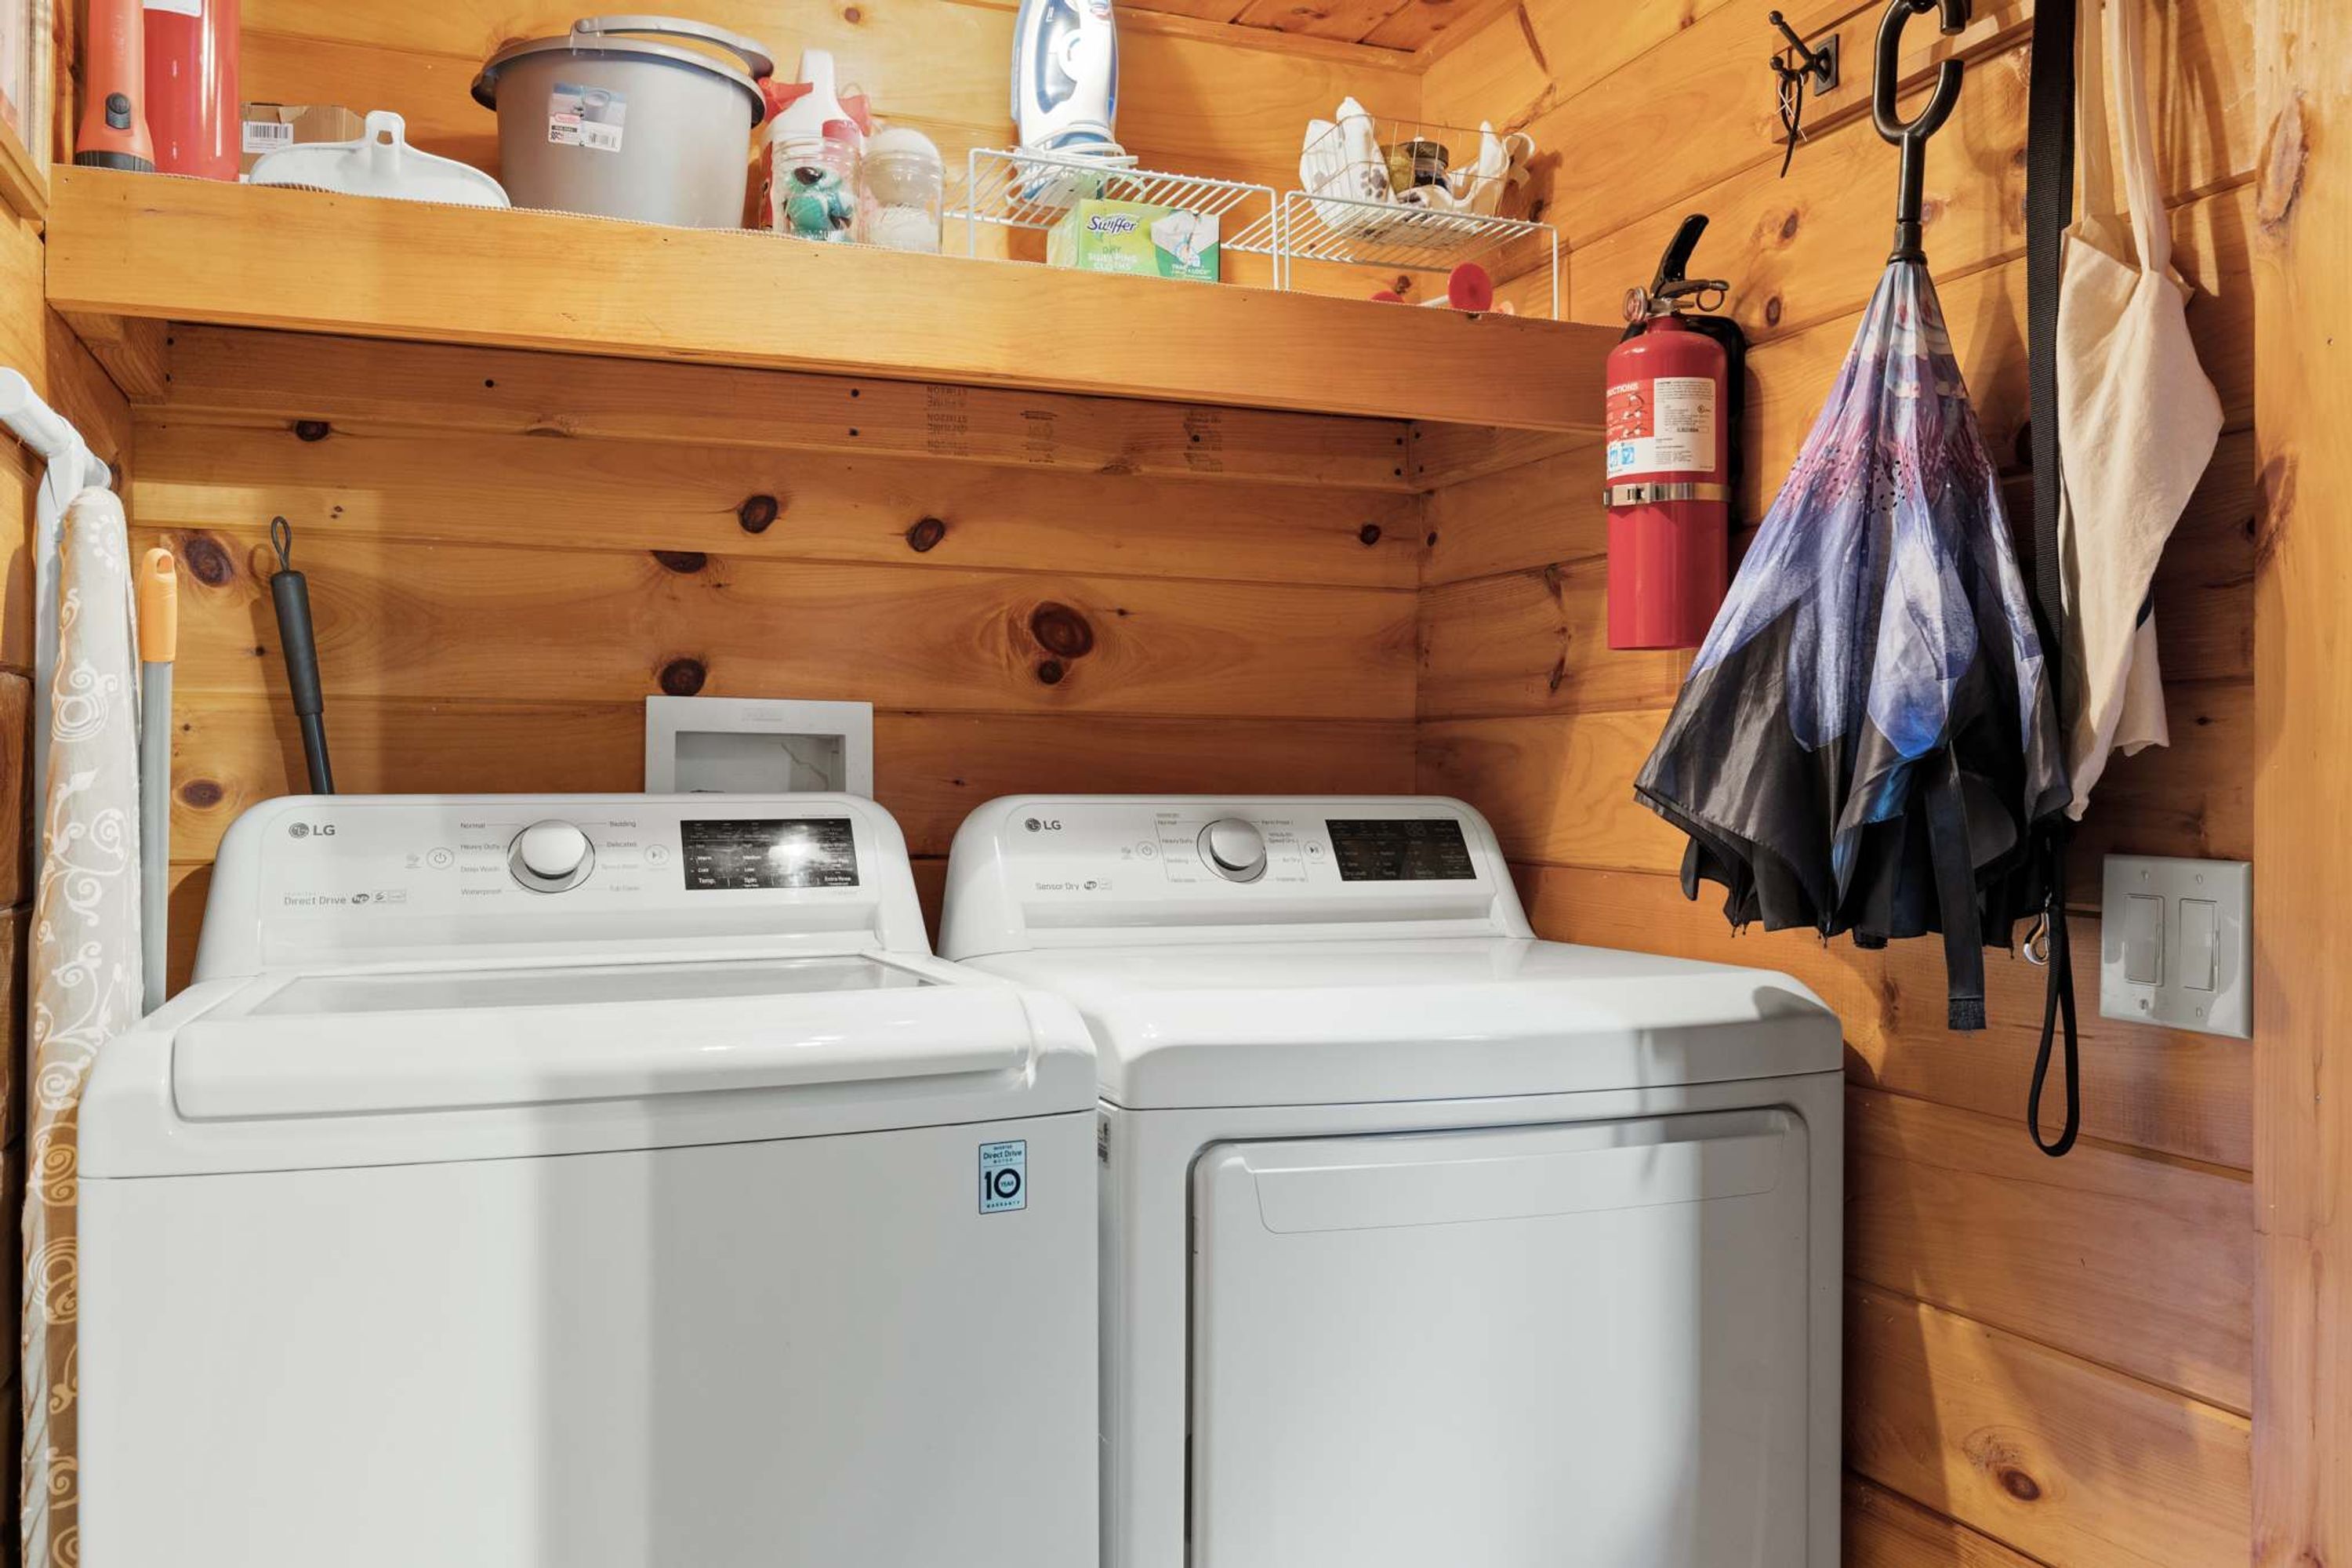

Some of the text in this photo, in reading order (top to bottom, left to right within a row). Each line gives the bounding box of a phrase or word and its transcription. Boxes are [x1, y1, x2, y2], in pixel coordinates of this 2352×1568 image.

[1087, 216, 1137, 234] Swiffer
[1044, 820, 1062, 830] LG
[313, 825, 336, 837] LG
[1035, 882, 1080, 891] Sensor Dry
[285, 896, 316, 906] Direct
[319, 895, 347, 905] Drive
[983, 1149, 1022, 1160] Direct Drive
[985, 1168, 1022, 1201] 10
